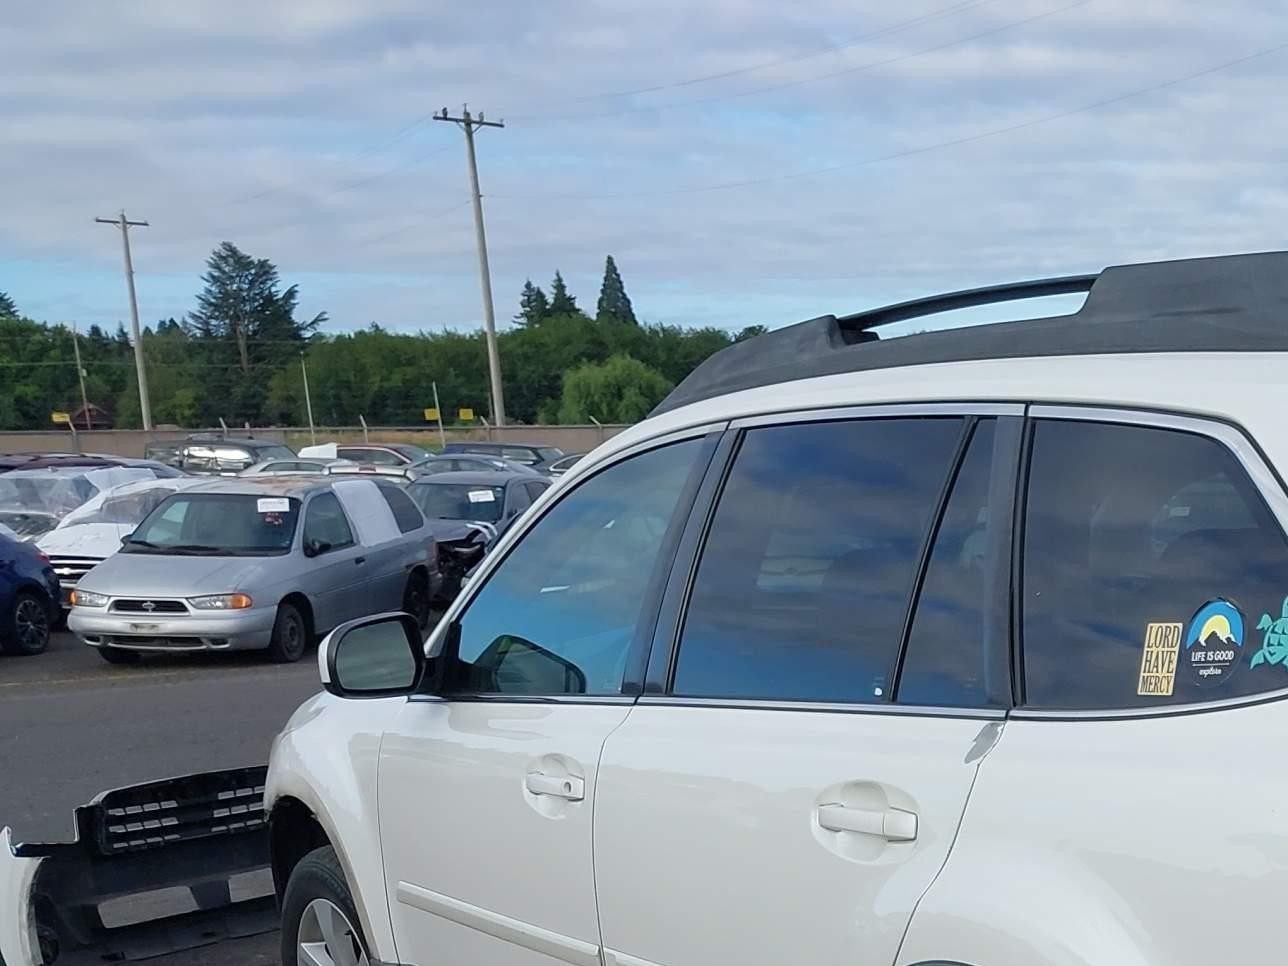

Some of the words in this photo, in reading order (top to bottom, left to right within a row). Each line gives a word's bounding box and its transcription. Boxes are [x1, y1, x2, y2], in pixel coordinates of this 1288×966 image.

[1147, 625, 1180, 648] LORD
[1143, 650, 1176, 674] HAVE
[1191, 651, 1206, 662] LIFE
[1207, 651, 1214, 661] IS
[1214, 650, 1235, 661] GOOD
[1140, 675, 1173, 694] MERCY
